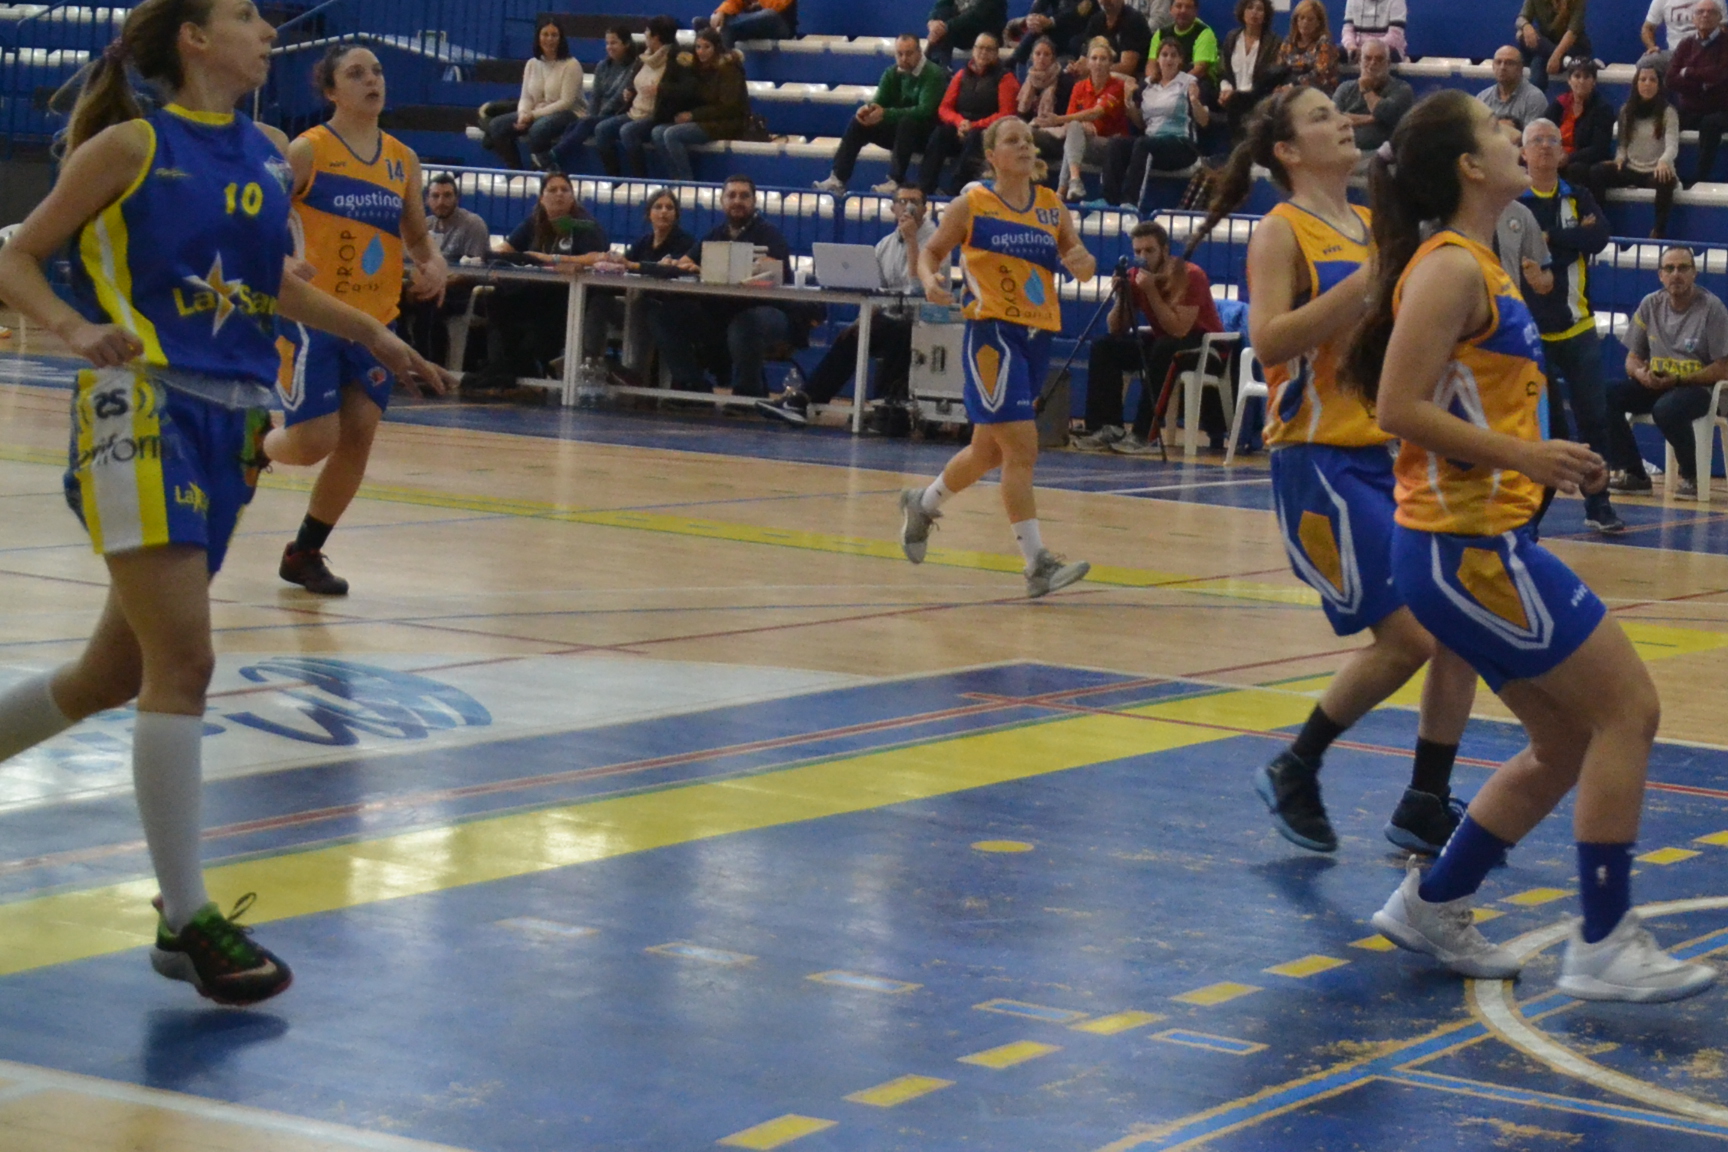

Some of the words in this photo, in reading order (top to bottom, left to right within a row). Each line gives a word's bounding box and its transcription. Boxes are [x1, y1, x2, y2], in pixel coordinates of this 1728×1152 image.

[385, 158, 405, 182] 14
[224, 182, 263, 215] 10
[172, 286, 217, 317] La
